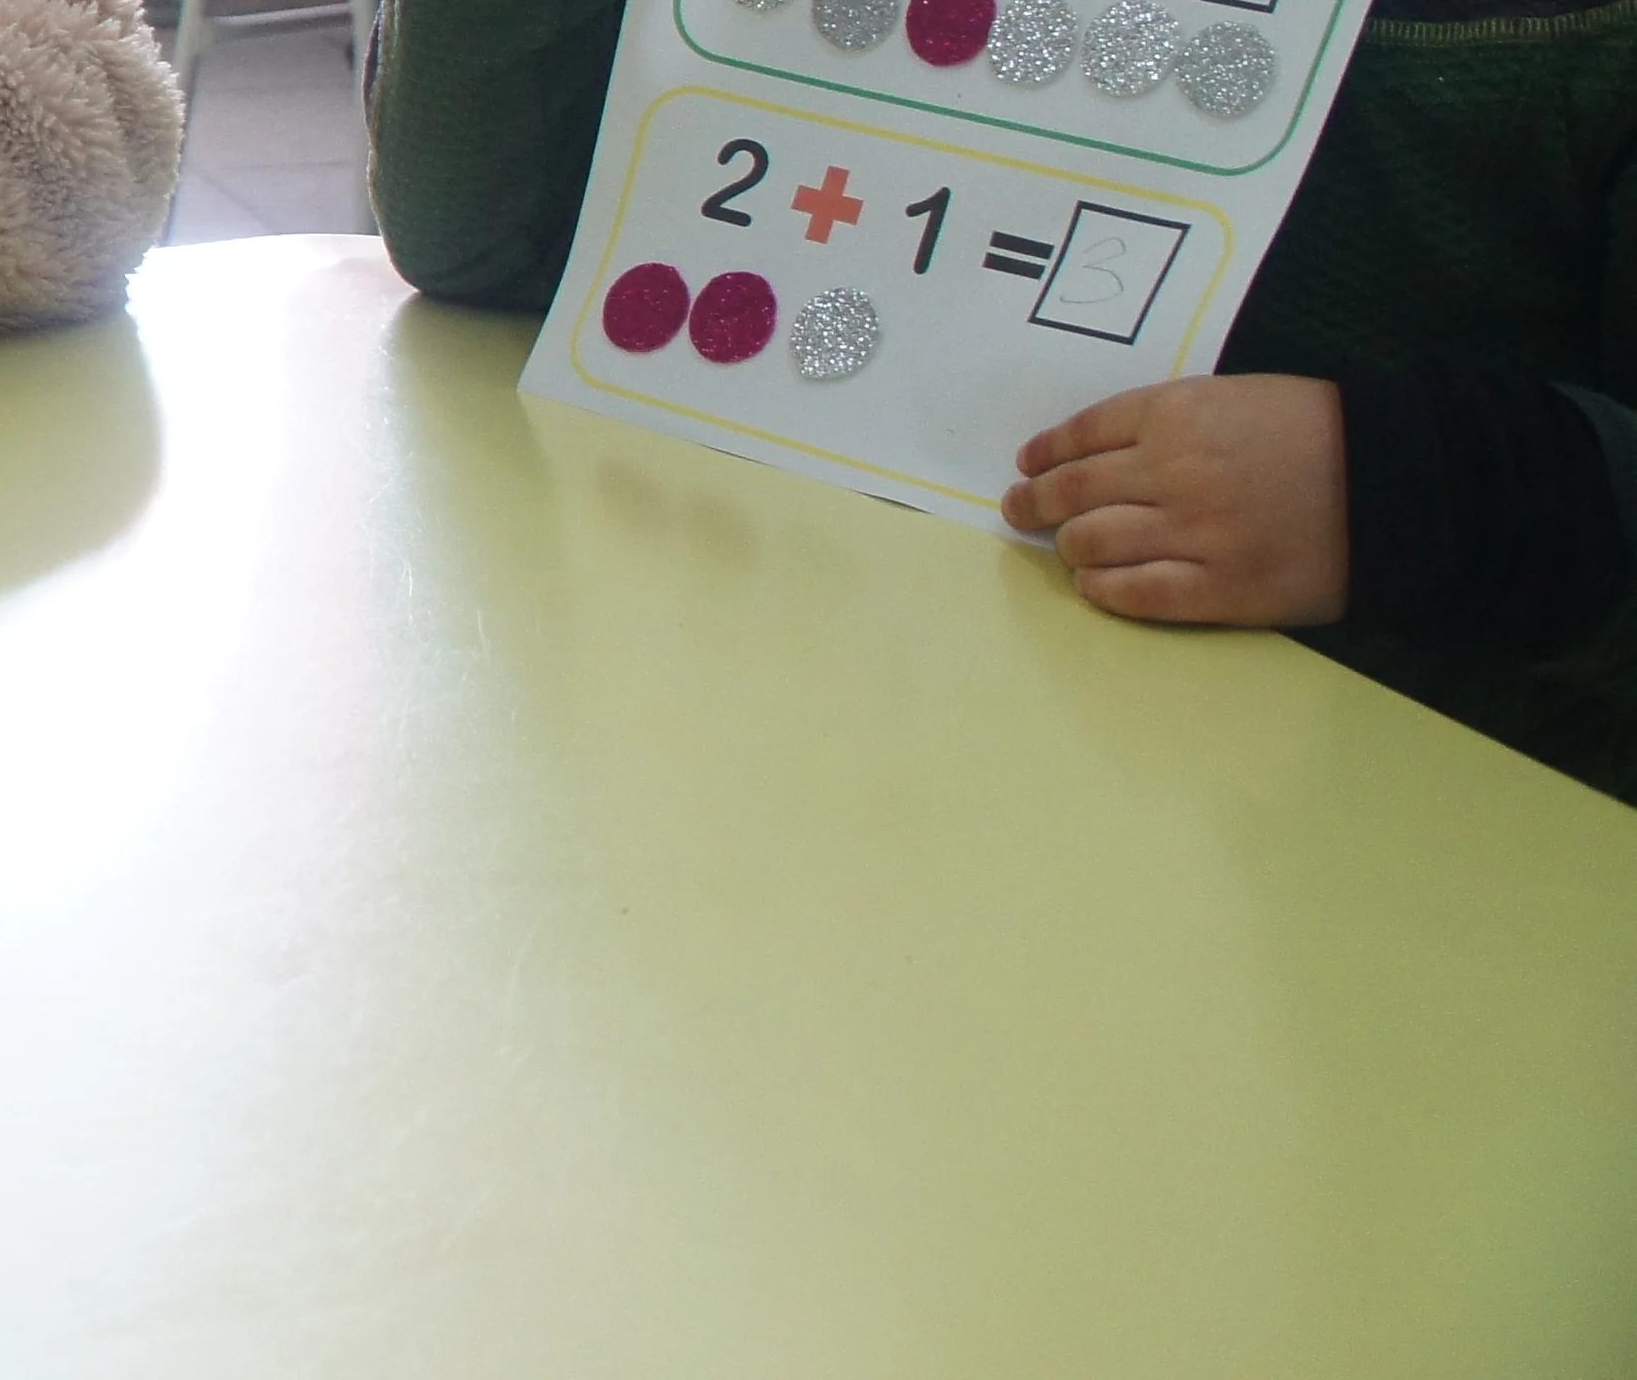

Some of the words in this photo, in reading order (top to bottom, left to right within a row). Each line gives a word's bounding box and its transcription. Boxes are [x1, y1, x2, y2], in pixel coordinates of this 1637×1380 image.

[700, 138, 770, 228] 2
[905, 186, 951, 275] 1
[982, 230, 1055, 280] =
[1059, 236, 1127, 304] 3
